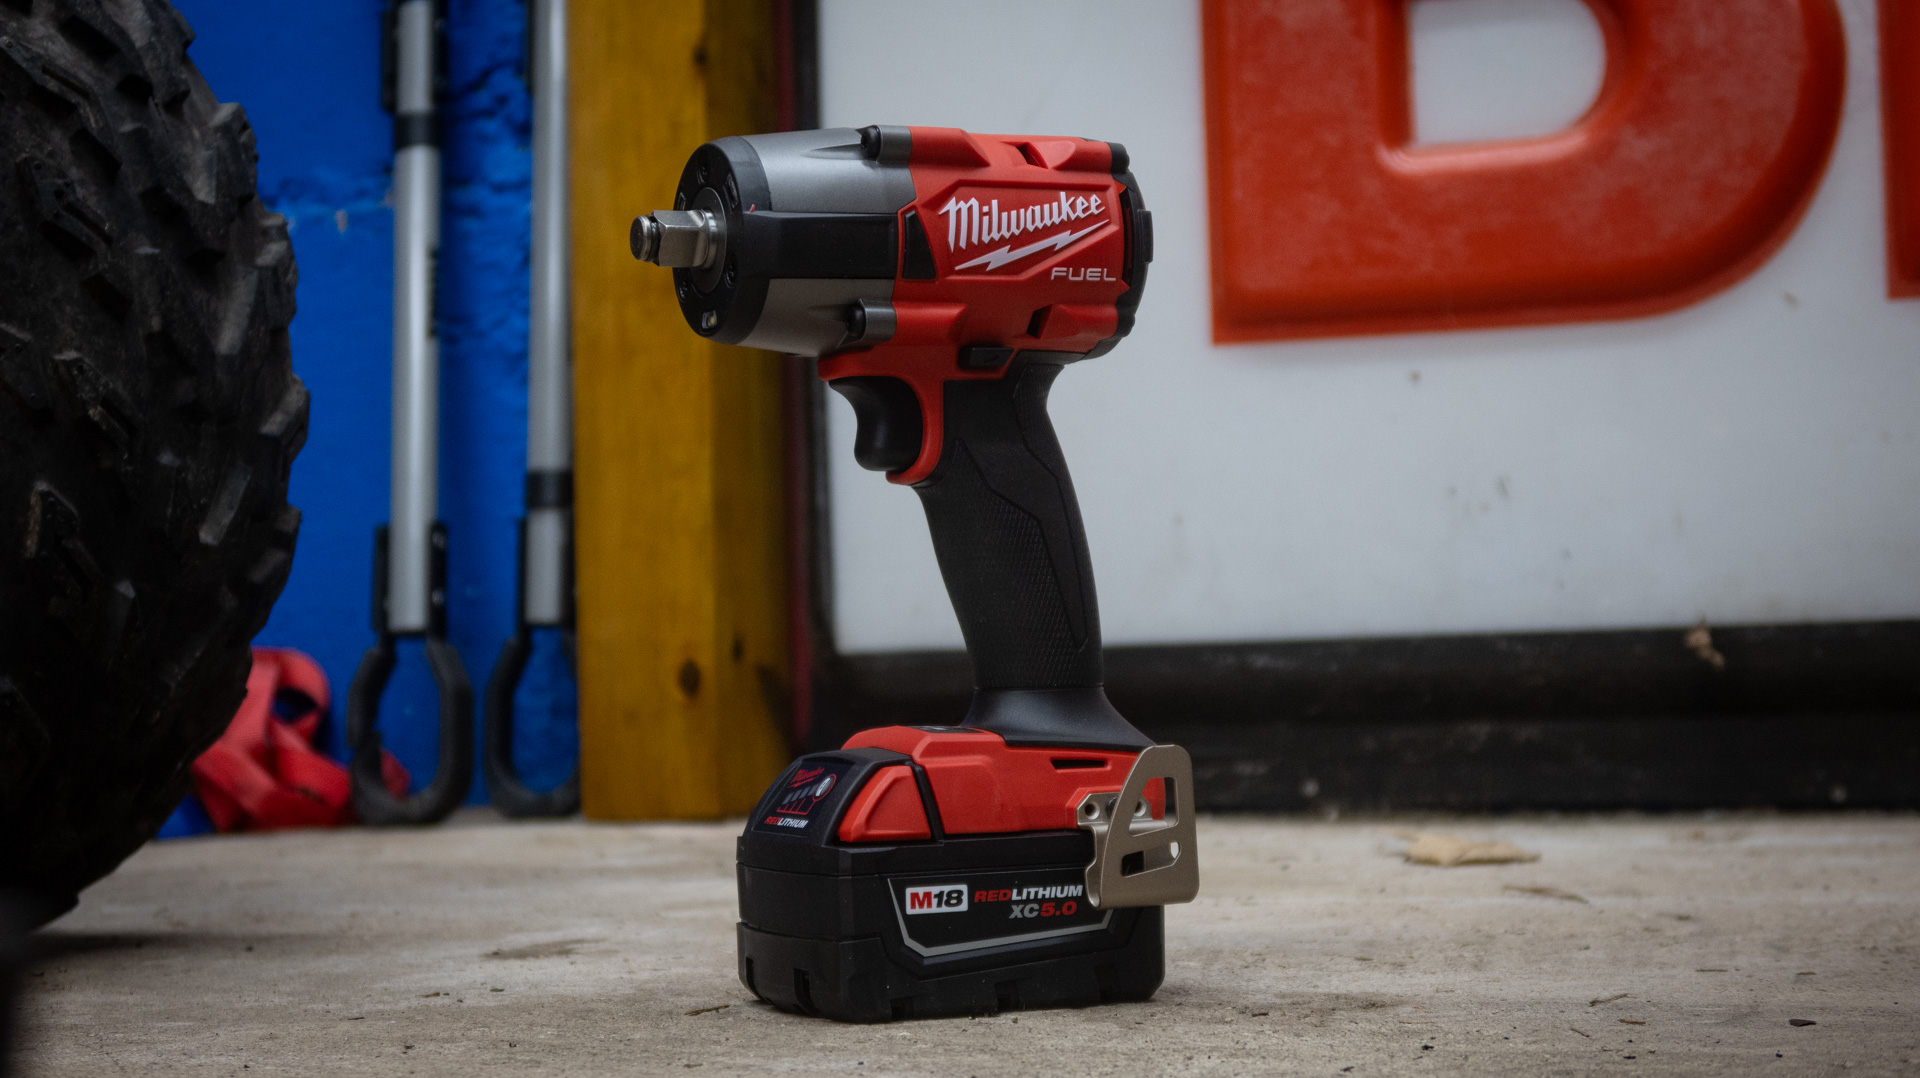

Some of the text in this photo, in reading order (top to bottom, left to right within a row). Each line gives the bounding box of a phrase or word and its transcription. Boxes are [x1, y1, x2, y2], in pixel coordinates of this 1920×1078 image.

[938, 191, 1106, 253] Milwaukee
[1050, 267, 1117, 281] FUEL
[909, 885, 1084, 910] M18 REDLITHIUM
[1008, 901, 1078, 919] XC5.0
